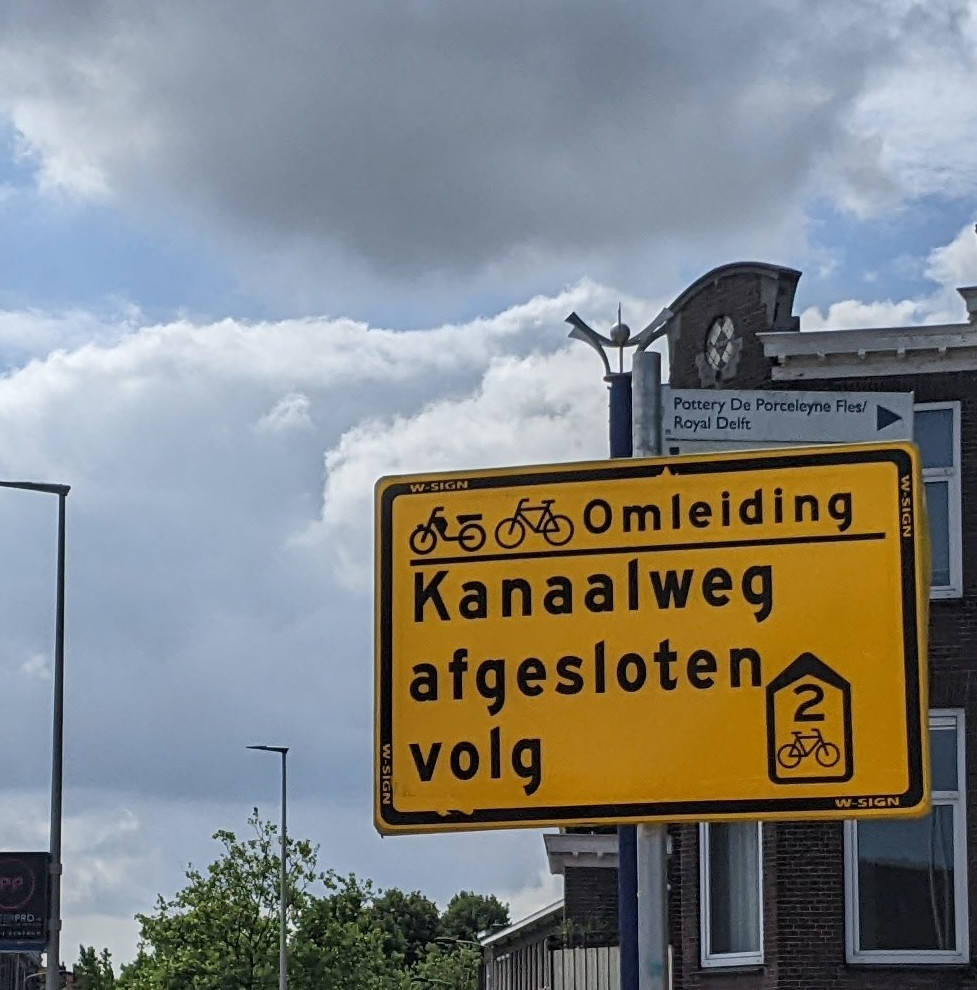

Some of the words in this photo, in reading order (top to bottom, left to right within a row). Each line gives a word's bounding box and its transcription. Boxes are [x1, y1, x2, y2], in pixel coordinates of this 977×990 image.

[673, 396, 726, 415] Pottery
[730, 397, 752, 412] De
[755, 398, 832, 416] Porceleyne
[836, 399, 868, 413] Fles/
[673, 416, 711, 433] Royal
[716, 416, 752, 430] Delft
[409, 480, 469, 493] W-SIGN
[583, 486, 853, 535] Omleiding
[900, 474, 913, 538] W-SIGN
[413, 558, 773, 623] Kanaalweg
[408, 638, 762, 717] afgesloten
[792, 683, 826, 723] 2
[382, 743, 392, 805] W-SIGN
[408, 726, 542, 796] volg
[835, 797, 900, 808] W-SIGN
